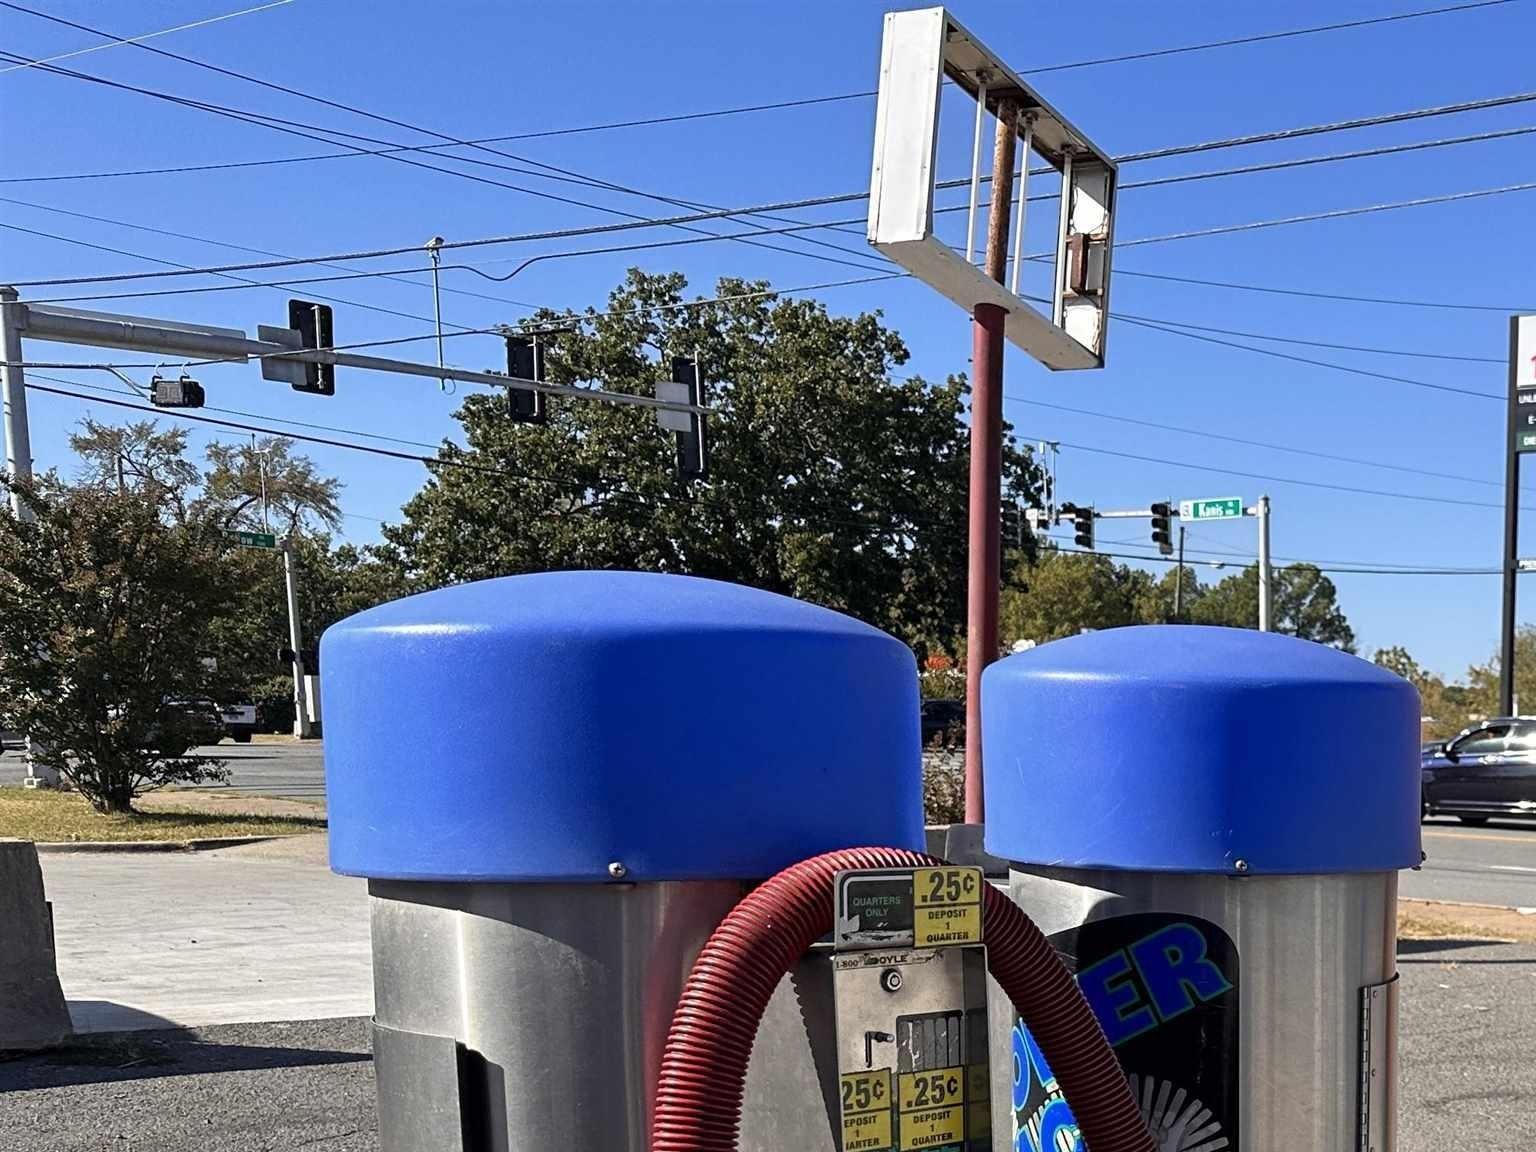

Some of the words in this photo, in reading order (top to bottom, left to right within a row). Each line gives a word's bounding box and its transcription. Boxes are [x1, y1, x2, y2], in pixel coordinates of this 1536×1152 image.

[852, 896, 901, 906] QUARTERS
[865, 908, 889, 917] ONLY
[928, 908, 967, 920] DEPOSIT
[945, 922, 950, 930] 1
[927, 931, 969, 942] QUARTER
[844, 1115, 877, 1128] EPOSIT
[913, 1110, 951, 1124] DEPOSIT
[855, 1129, 860, 1137] 1
[912, 1132, 952, 1146] QUARTER
